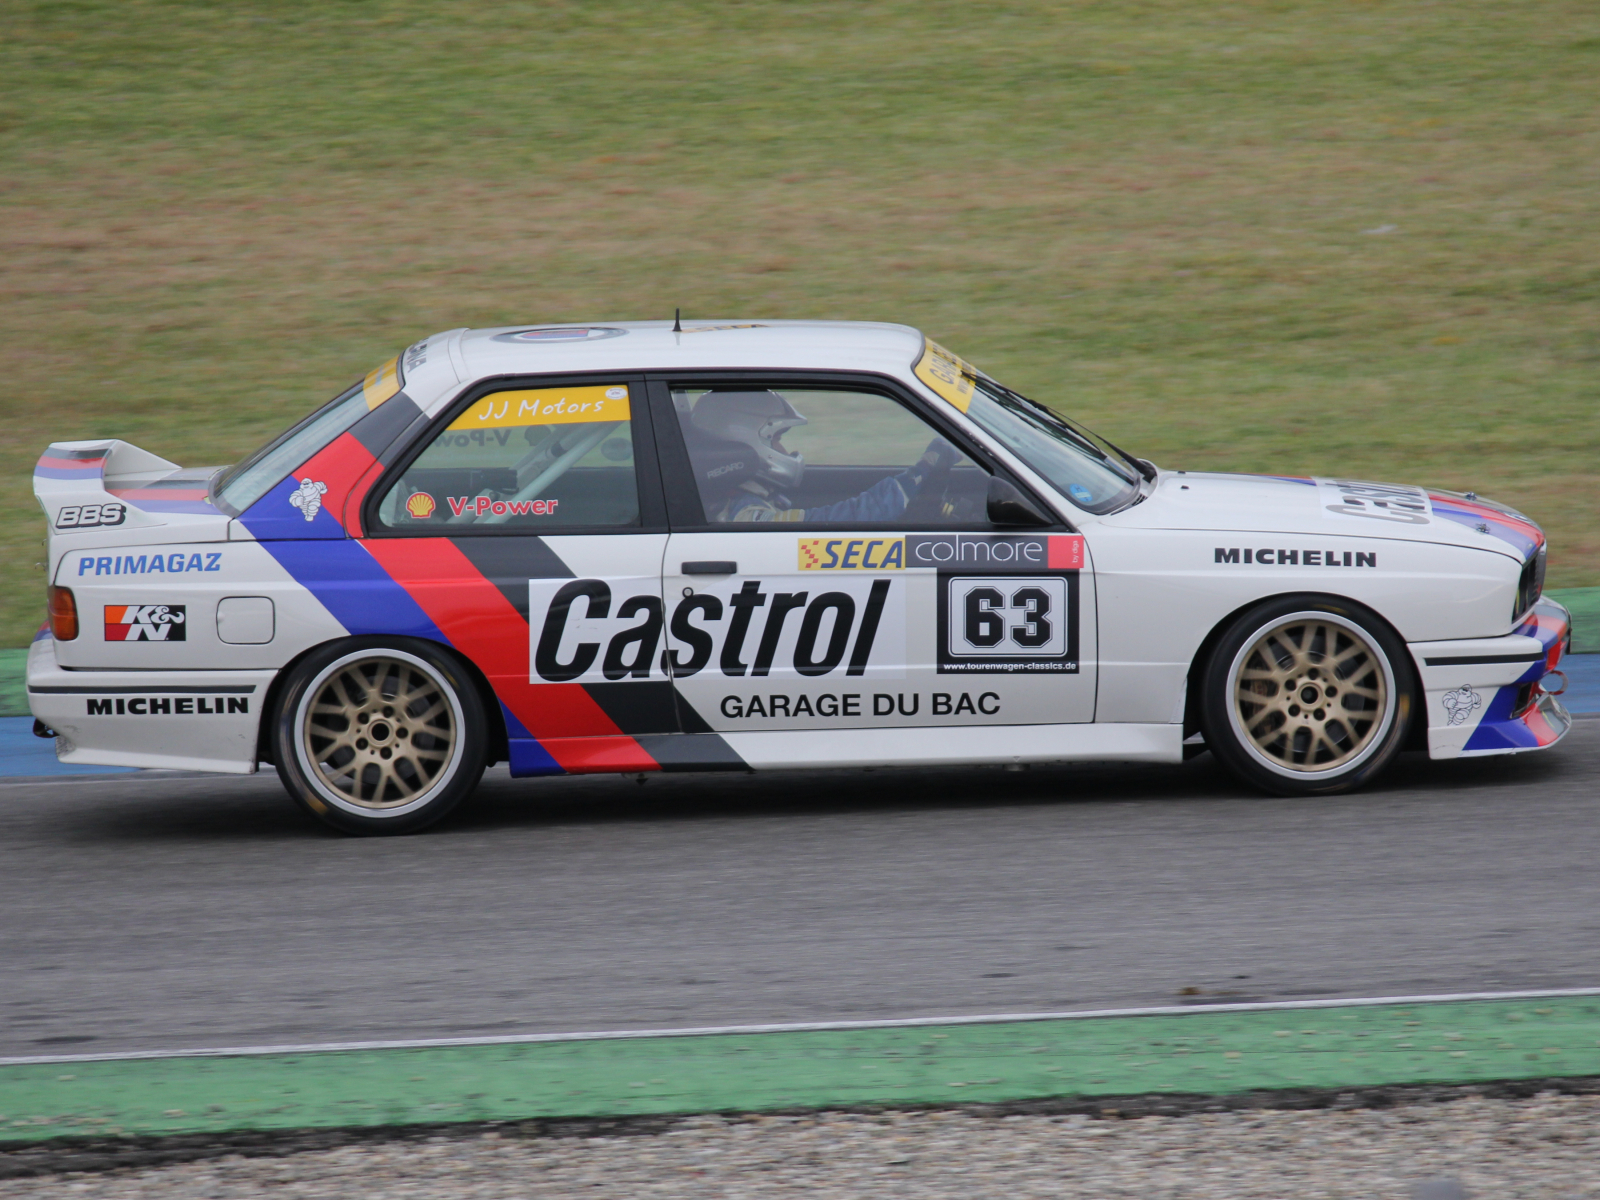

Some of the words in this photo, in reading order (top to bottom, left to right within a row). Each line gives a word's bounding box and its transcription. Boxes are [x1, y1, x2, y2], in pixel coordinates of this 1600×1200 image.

[478, 400, 509, 421] JJ
[518, 397, 605, 418] Motors
[707, 461, 745, 479] RECARO
[55, 503, 127, 529] BBS
[447, 496, 559, 516] V-Power
[821, 540, 903, 569] SECA
[915, 534, 1043, 562] colmore
[1214, 547, 1377, 567] MICHELIN
[78, 552, 223, 576] PRIMAGAZ
[963, 586, 1052, 649] 63
[535, 579, 893, 683] Castrol
[943, 662, 1077, 672] www.tourenwagen-classics.de
[87, 697, 249, 715] MICHELIN
[720, 693, 861, 718] GARAGE
[873, 692, 919, 717] DU
[931, 691, 1001, 716] BAC
